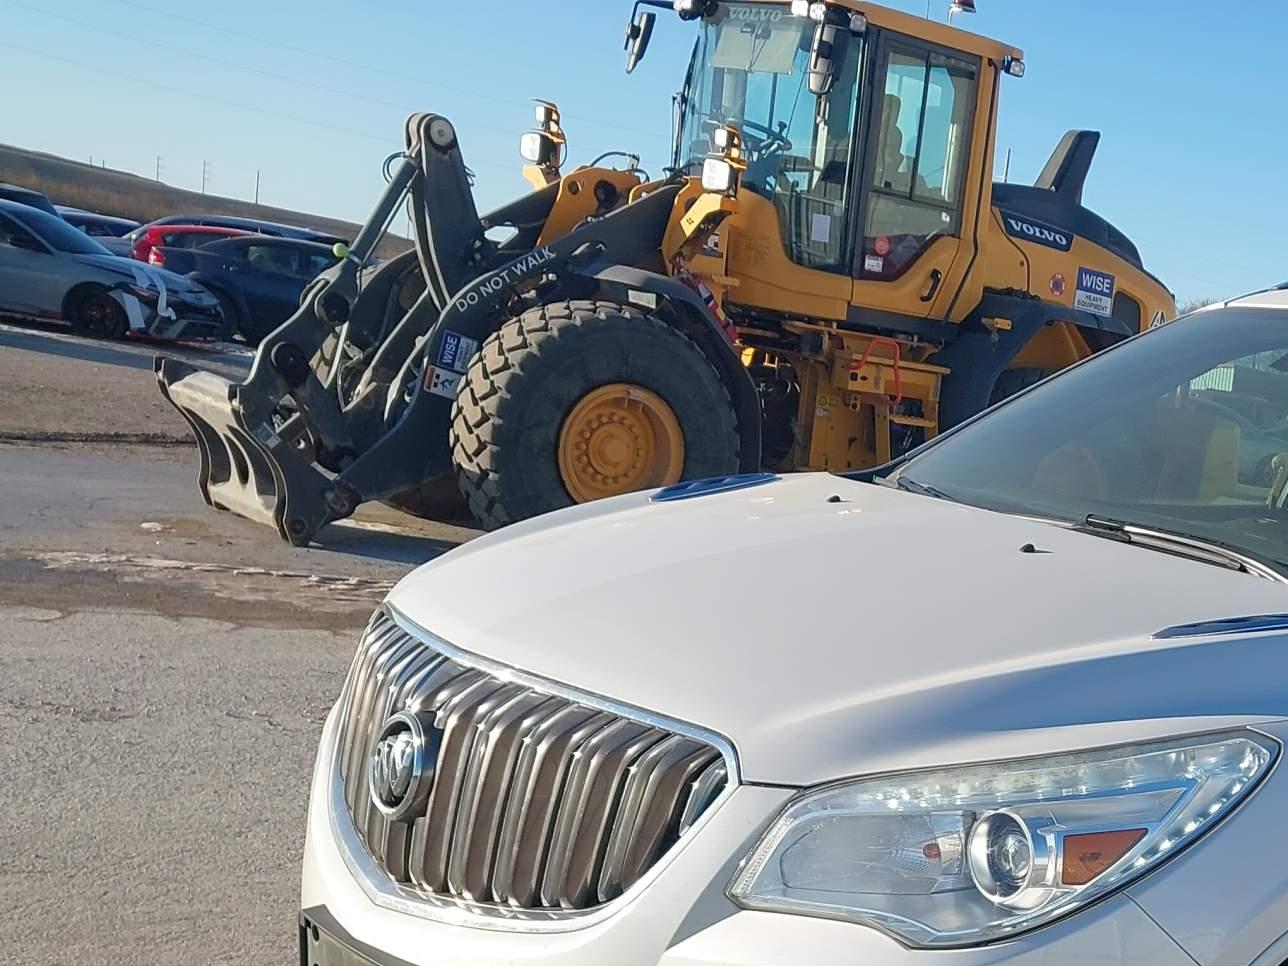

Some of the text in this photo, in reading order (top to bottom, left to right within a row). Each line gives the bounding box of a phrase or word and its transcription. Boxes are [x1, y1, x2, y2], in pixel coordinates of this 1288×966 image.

[728, 6, 783, 22] VOLVO
[1007, 218, 1067, 246] VOLVO
[455, 245, 557, 313] DO NOT WALK
[1082, 271, 1112, 293] WISE
[1076, 298, 1108, 312] EQUIPMENT
[1084, 293, 1104, 305] HEAVY
[441, 335, 458, 364] WISE
